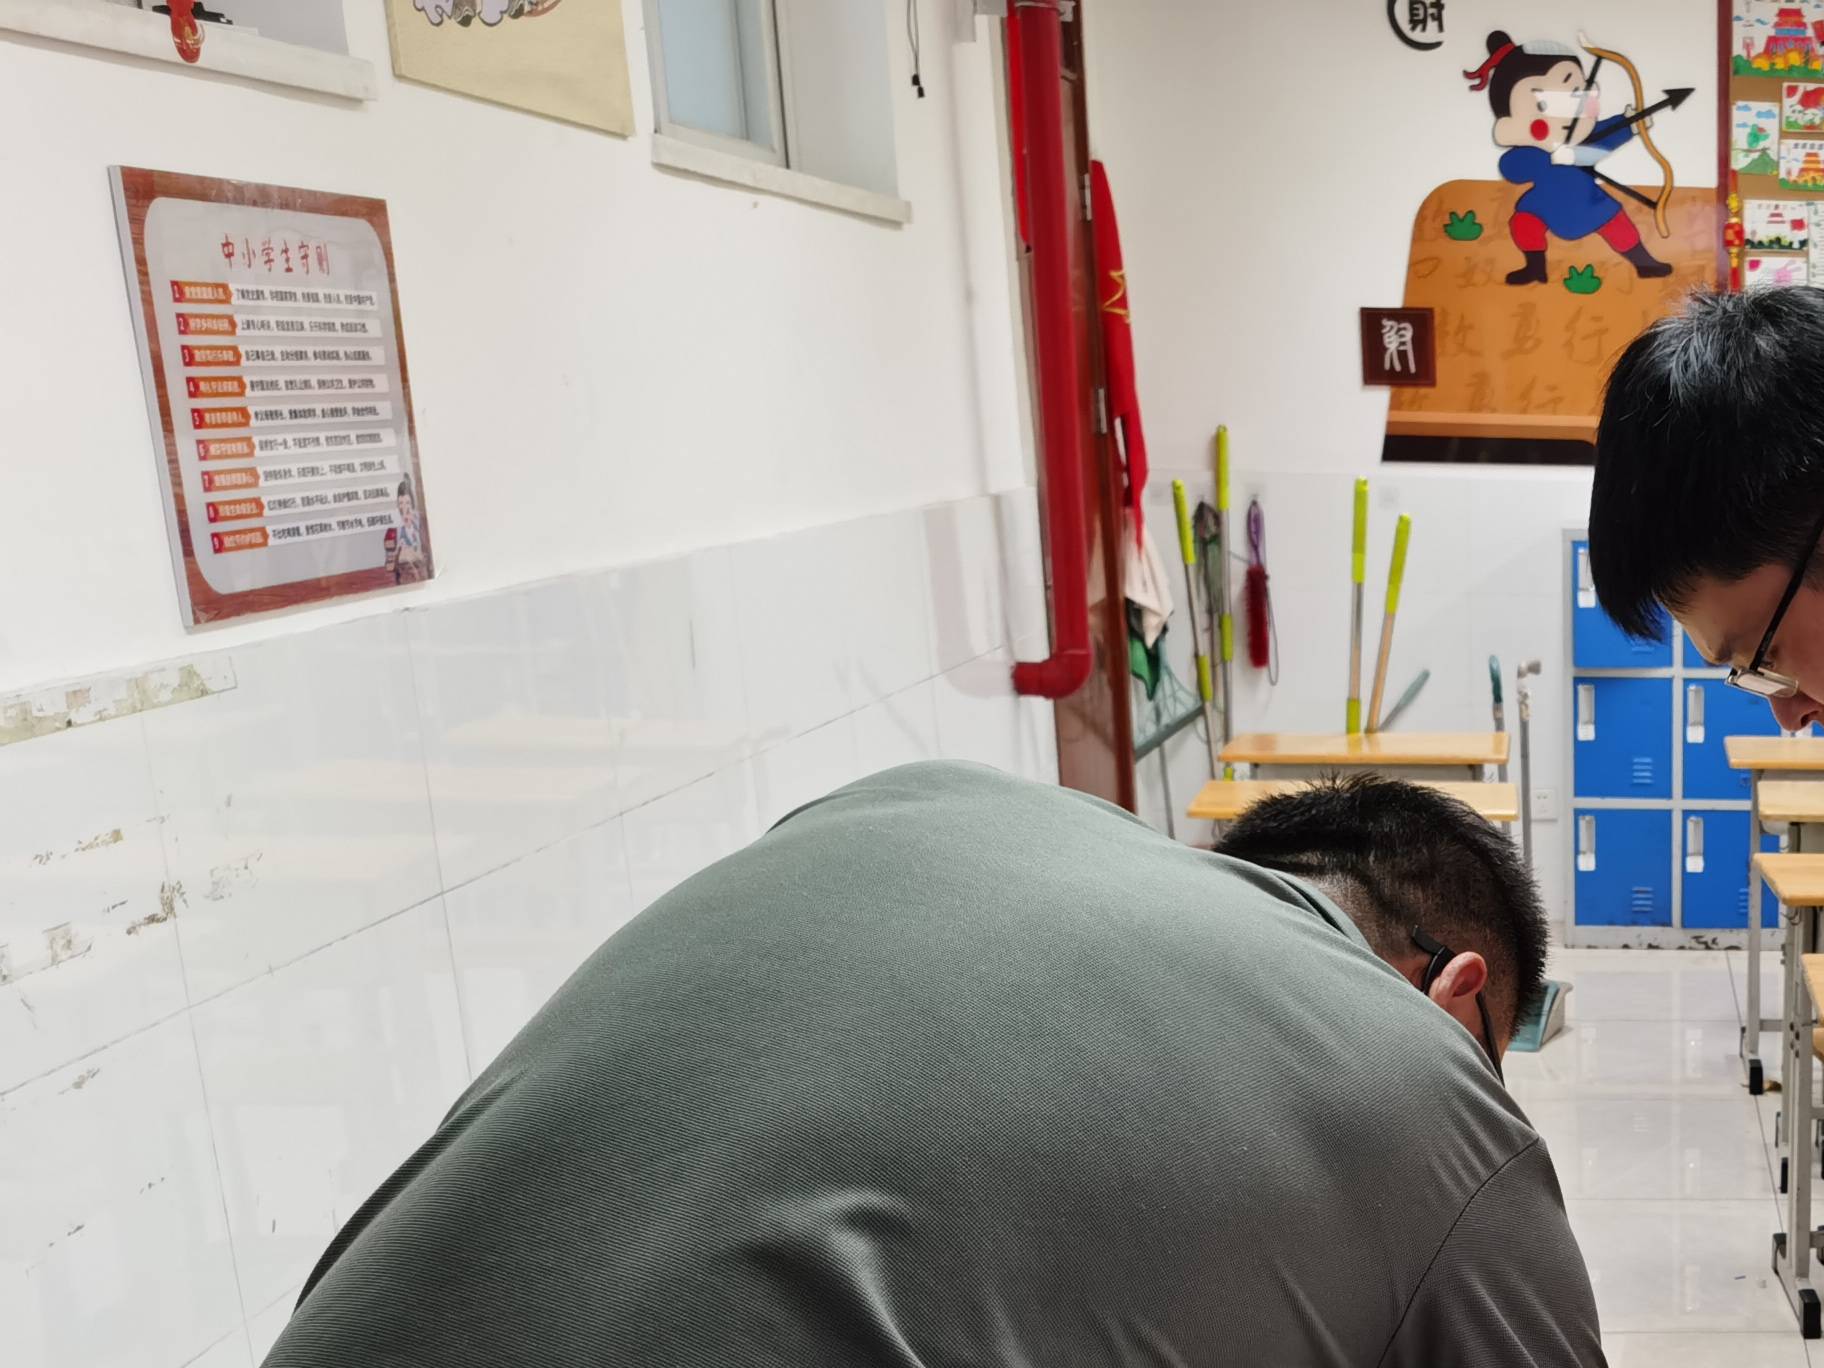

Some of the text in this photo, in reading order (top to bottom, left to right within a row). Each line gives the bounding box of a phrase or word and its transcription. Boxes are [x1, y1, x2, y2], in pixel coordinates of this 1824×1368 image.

[220, 233, 331, 276] 中小学生守则
